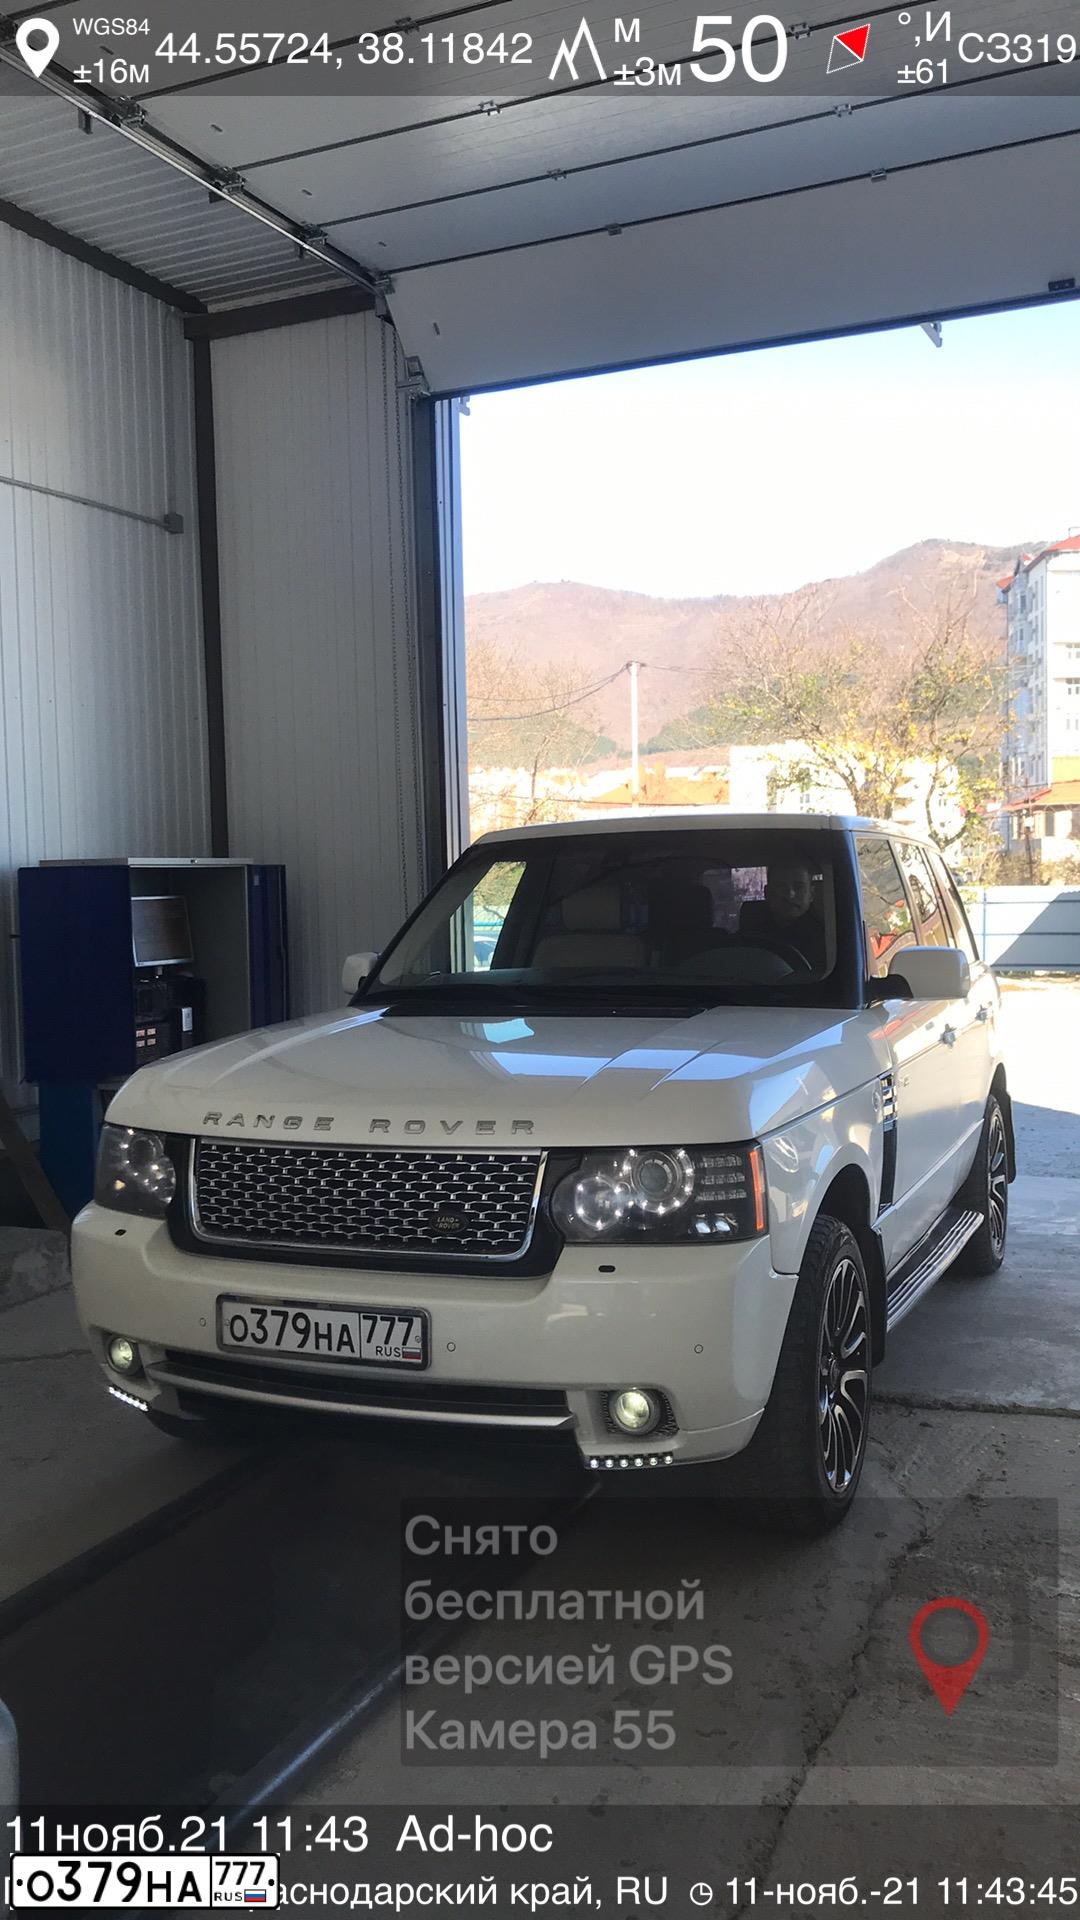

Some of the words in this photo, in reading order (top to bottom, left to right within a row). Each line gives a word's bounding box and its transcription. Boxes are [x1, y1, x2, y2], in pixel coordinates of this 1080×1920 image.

[202, 1111, 335, 1132] RANGE
[369, 1118, 534, 1136] ROVER
[362, 1314, 415, 1346] 777
[375, 1345, 402, 1358] RUS
